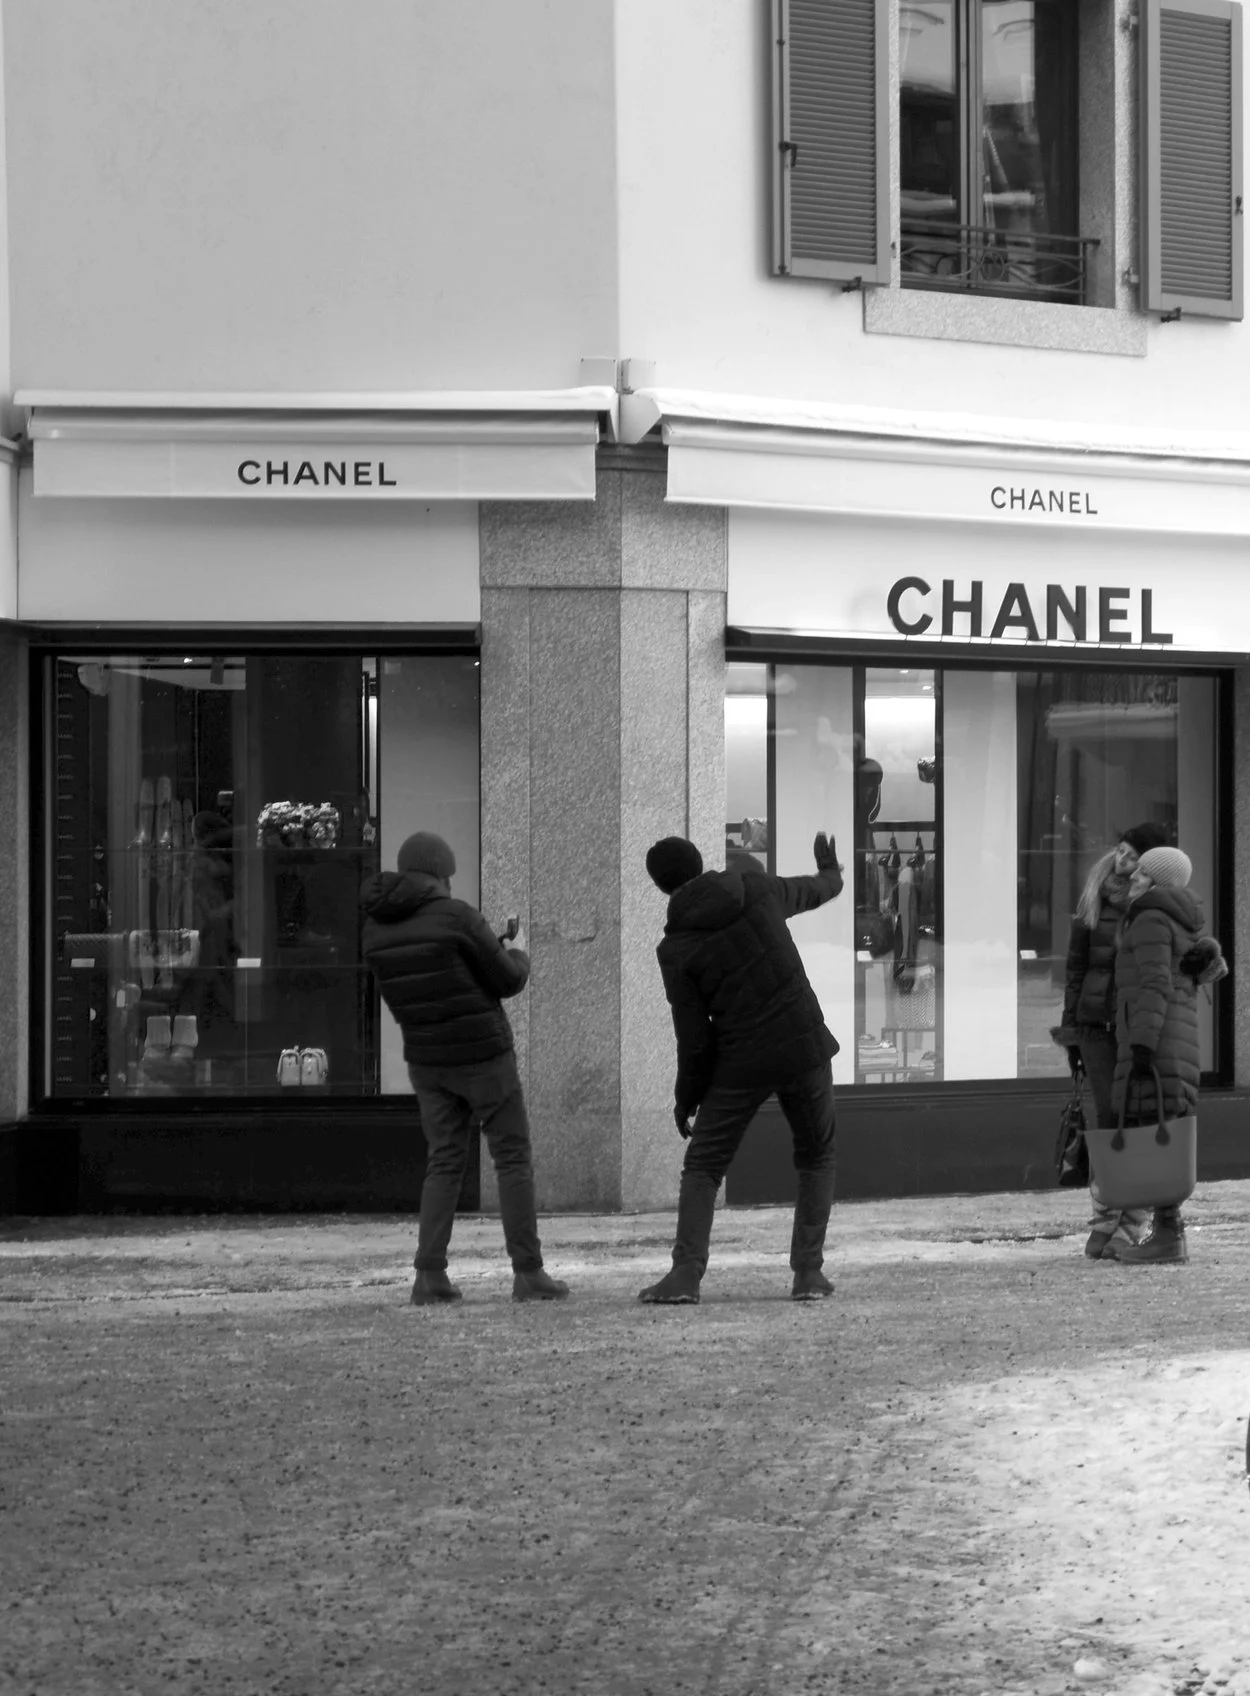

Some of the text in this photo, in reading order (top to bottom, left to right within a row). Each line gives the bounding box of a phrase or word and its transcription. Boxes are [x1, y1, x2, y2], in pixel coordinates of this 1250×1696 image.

[238, 460, 397, 486] CHANEL
[991, 486, 1098, 515] CHANEL
[887, 576, 1174, 645] CHANEL
